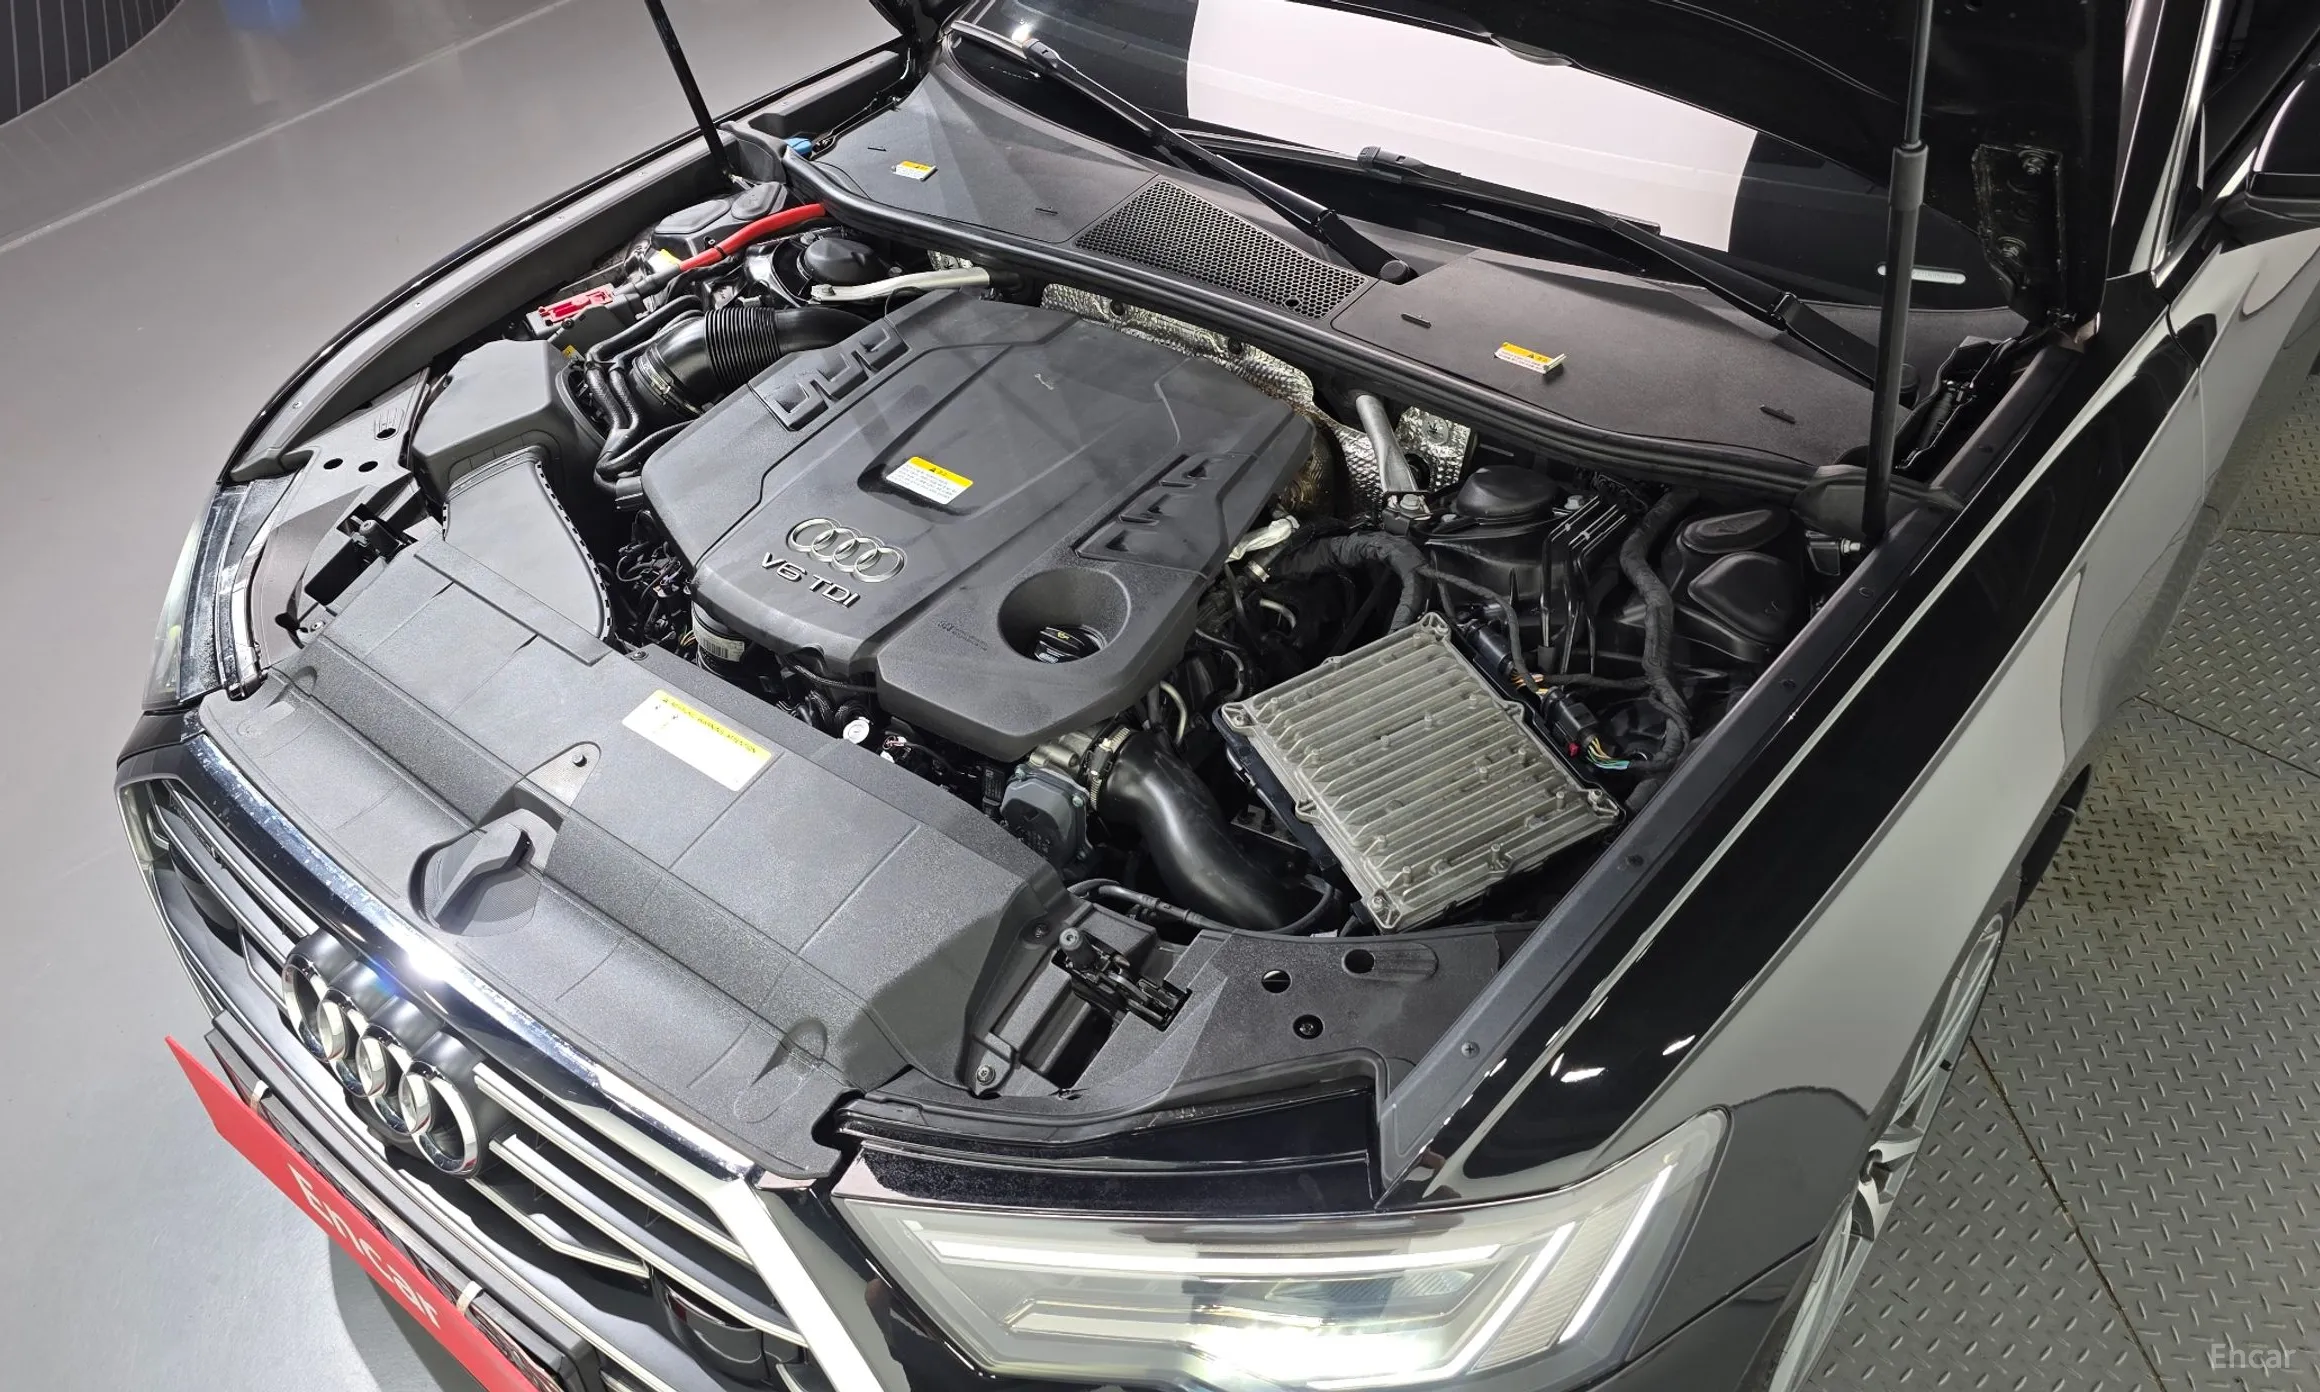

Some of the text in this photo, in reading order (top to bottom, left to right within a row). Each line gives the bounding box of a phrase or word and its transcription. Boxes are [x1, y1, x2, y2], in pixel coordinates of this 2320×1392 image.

[761, 551, 861, 608] V6 TDI
[287, 1163, 441, 1330] Encar
